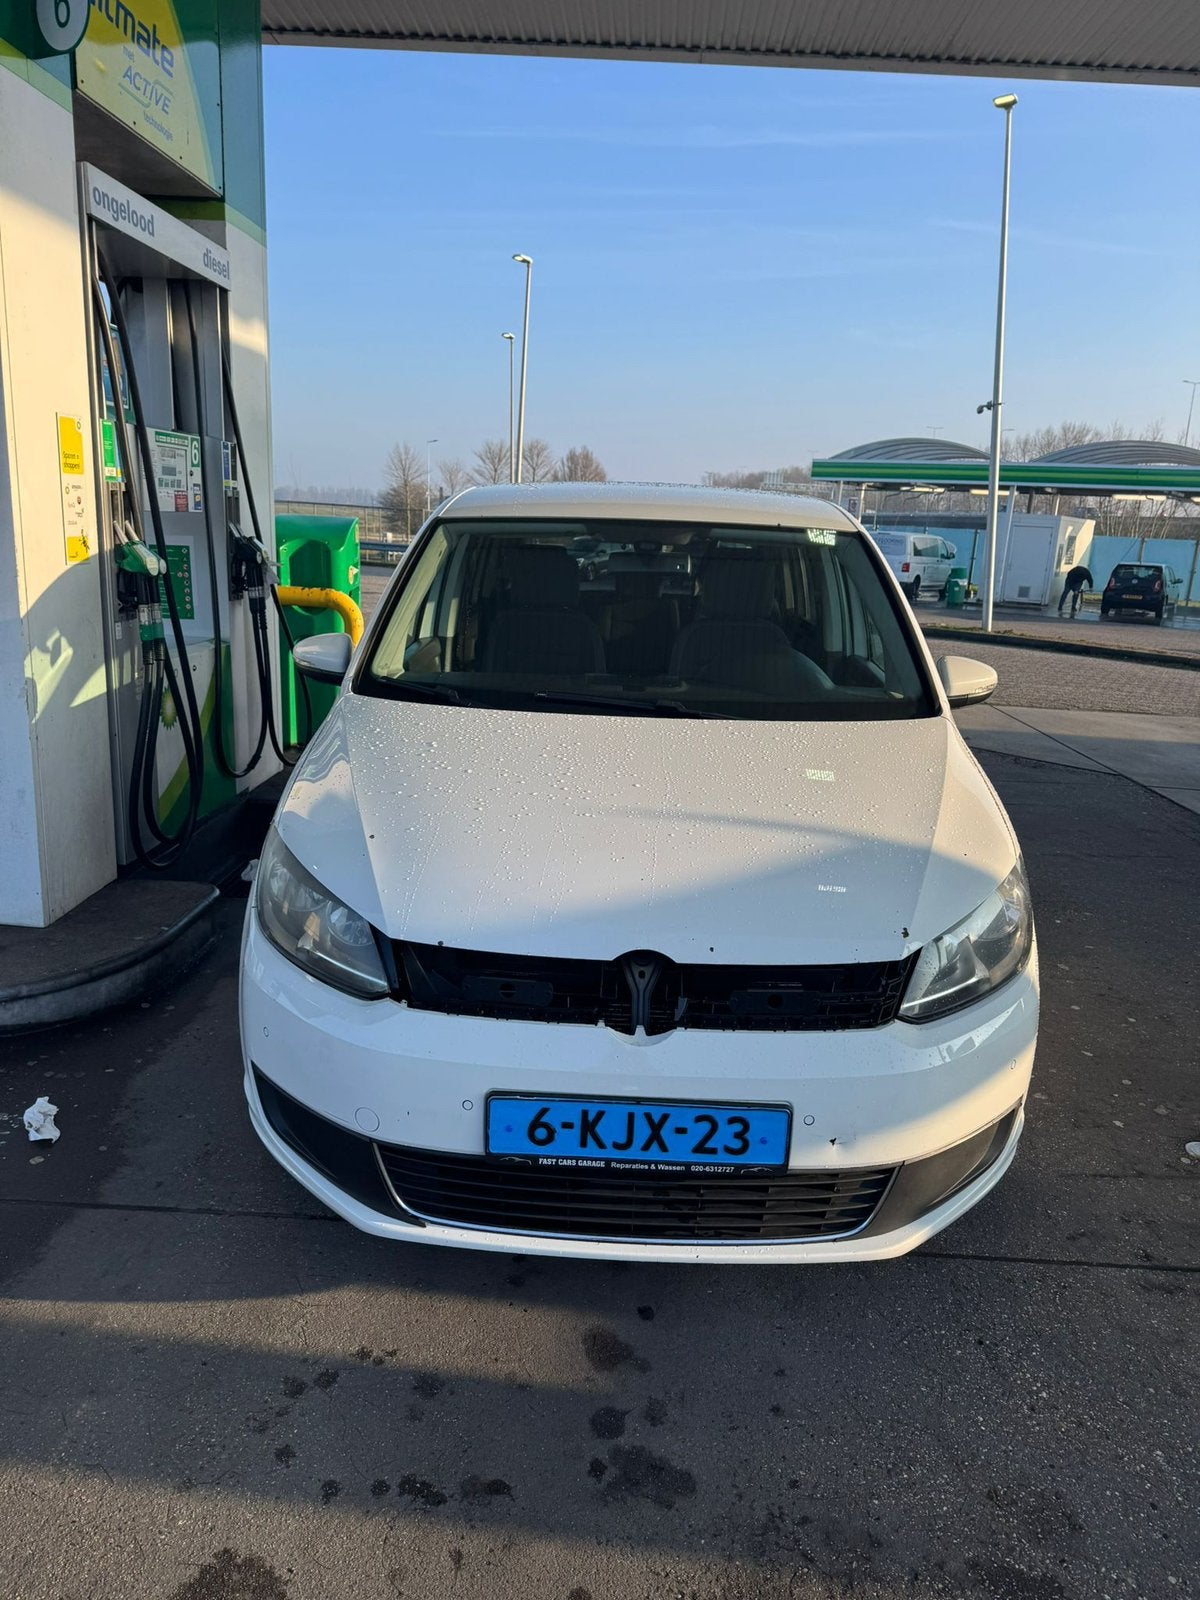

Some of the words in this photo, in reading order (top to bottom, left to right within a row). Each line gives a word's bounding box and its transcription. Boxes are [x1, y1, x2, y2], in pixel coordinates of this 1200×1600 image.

[122, 65, 171, 115] ACTIVE
[92, 186, 155, 237] ongelood
[203, 247, 230, 280] diesel
[191, 441, 200, 464] 6
[527, 1107, 750, 1156] 6-KJX-23
[538, 1157, 557, 1165] FAST
[578, 1159, 606, 1167] GARAGE
[610, 1161, 649, 1170] Reparaties
[657, 1163, 685, 1171] Wassen
[690, 1165, 735, 1173] 020-6312727
